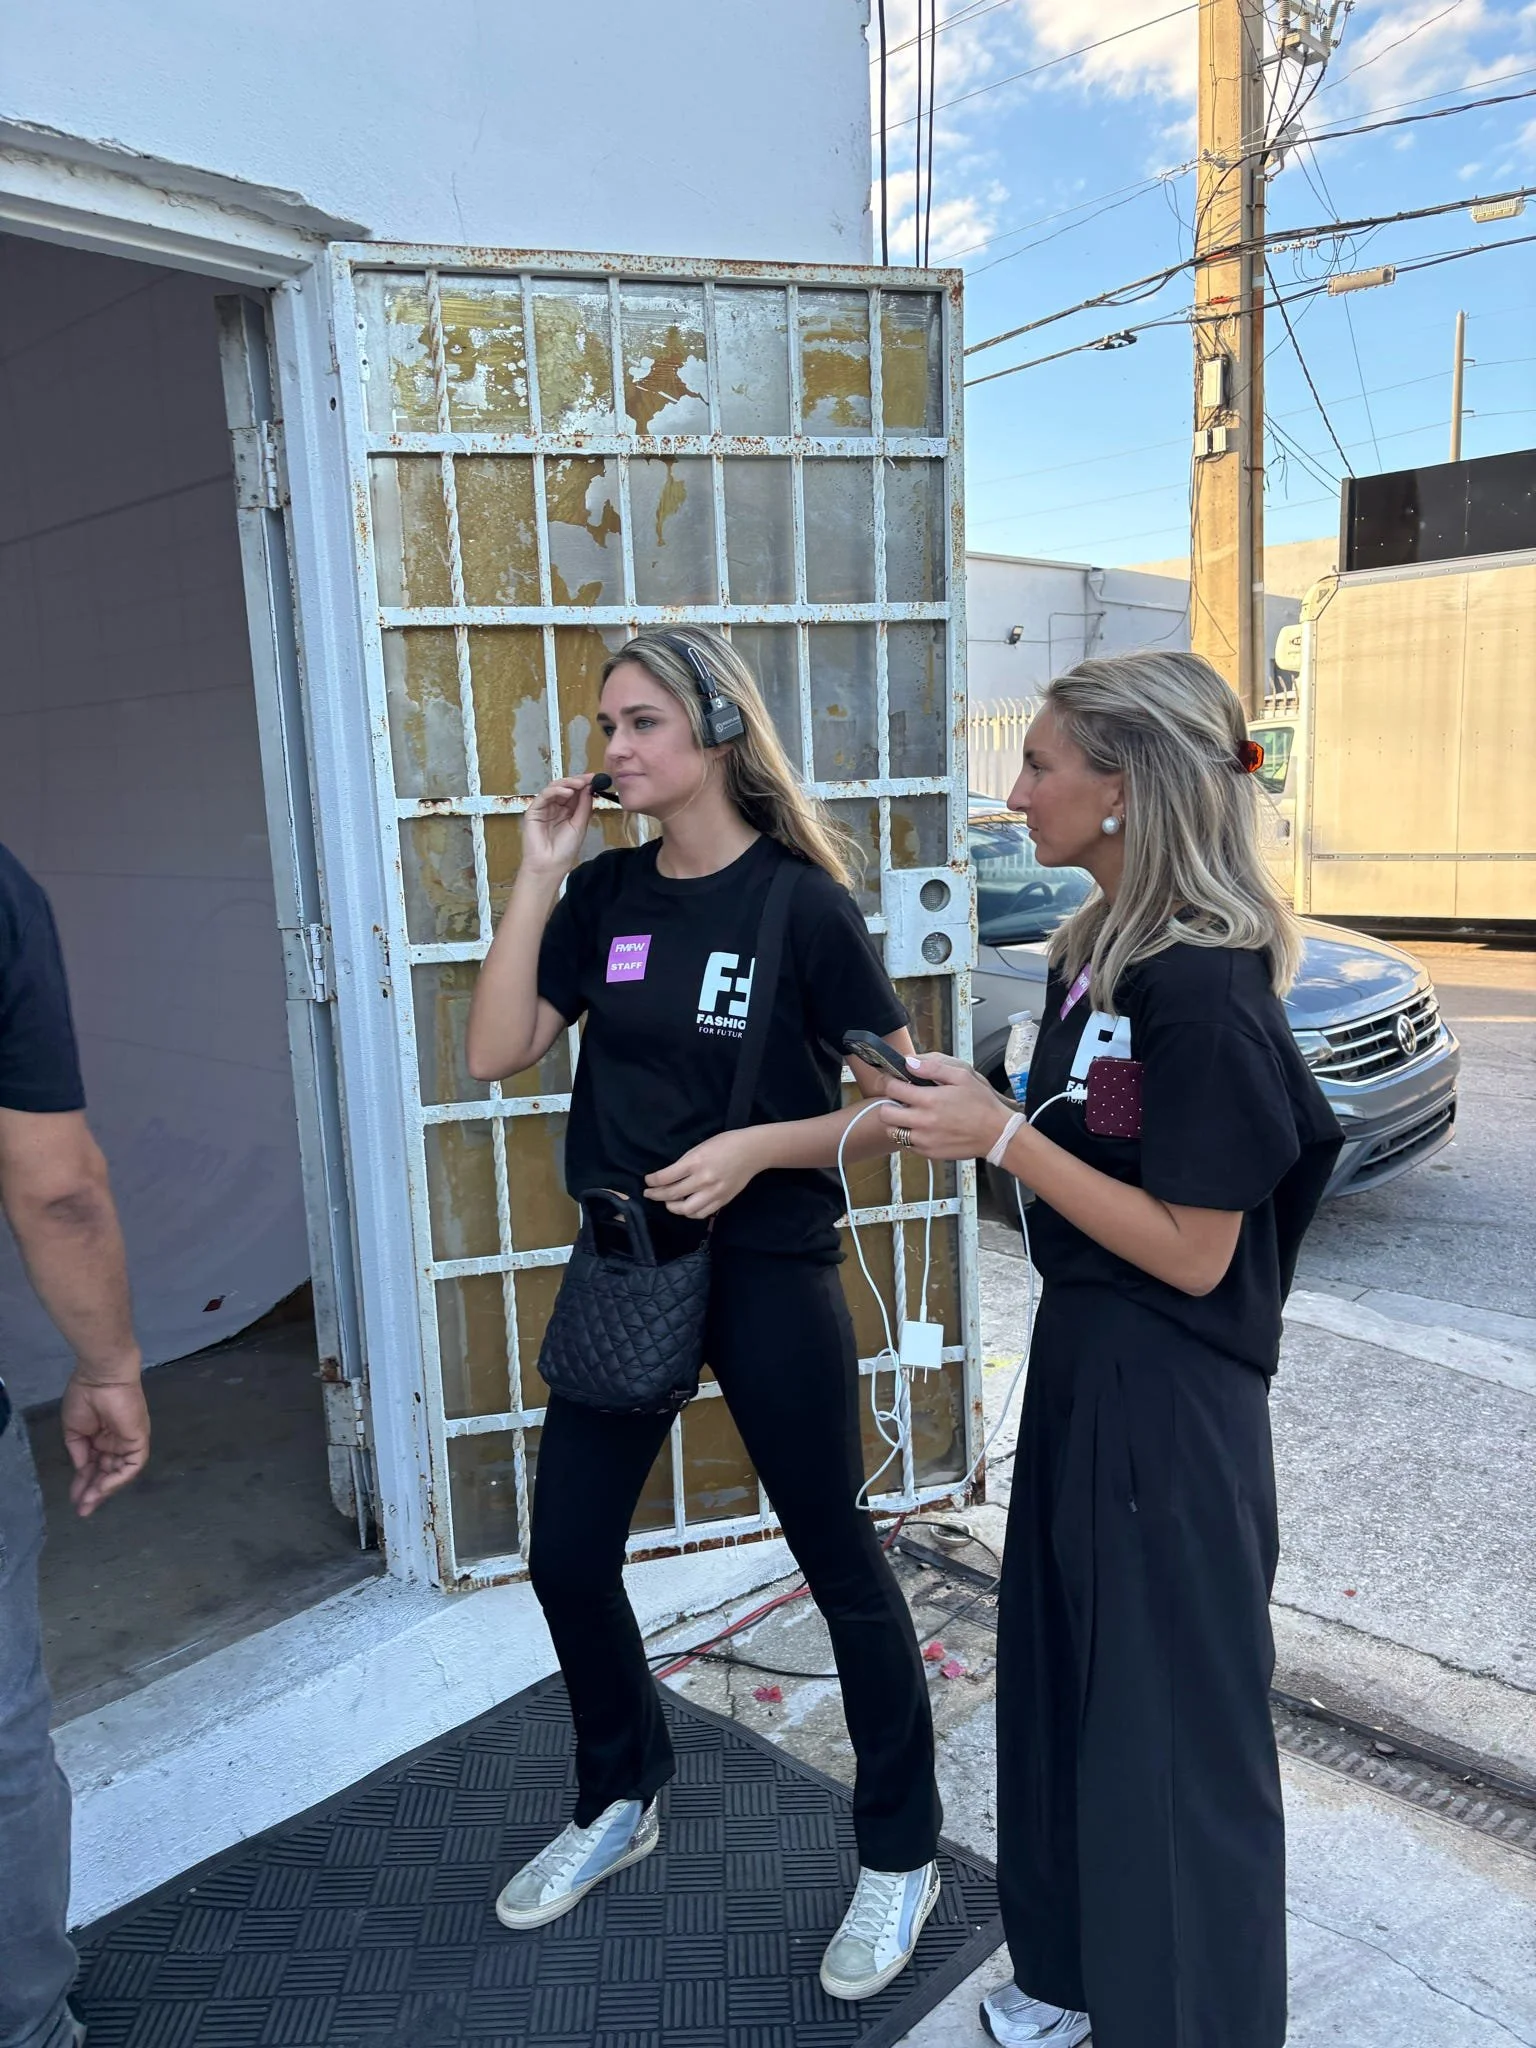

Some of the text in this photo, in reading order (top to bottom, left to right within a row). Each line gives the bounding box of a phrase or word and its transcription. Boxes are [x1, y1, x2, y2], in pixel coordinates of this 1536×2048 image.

[715, 698, 723, 708] 3
[611, 962, 643, 971] STAFF
[696, 1013, 747, 1030] FASHIO
[698, 1026, 743, 1039] FOR FUTUR
